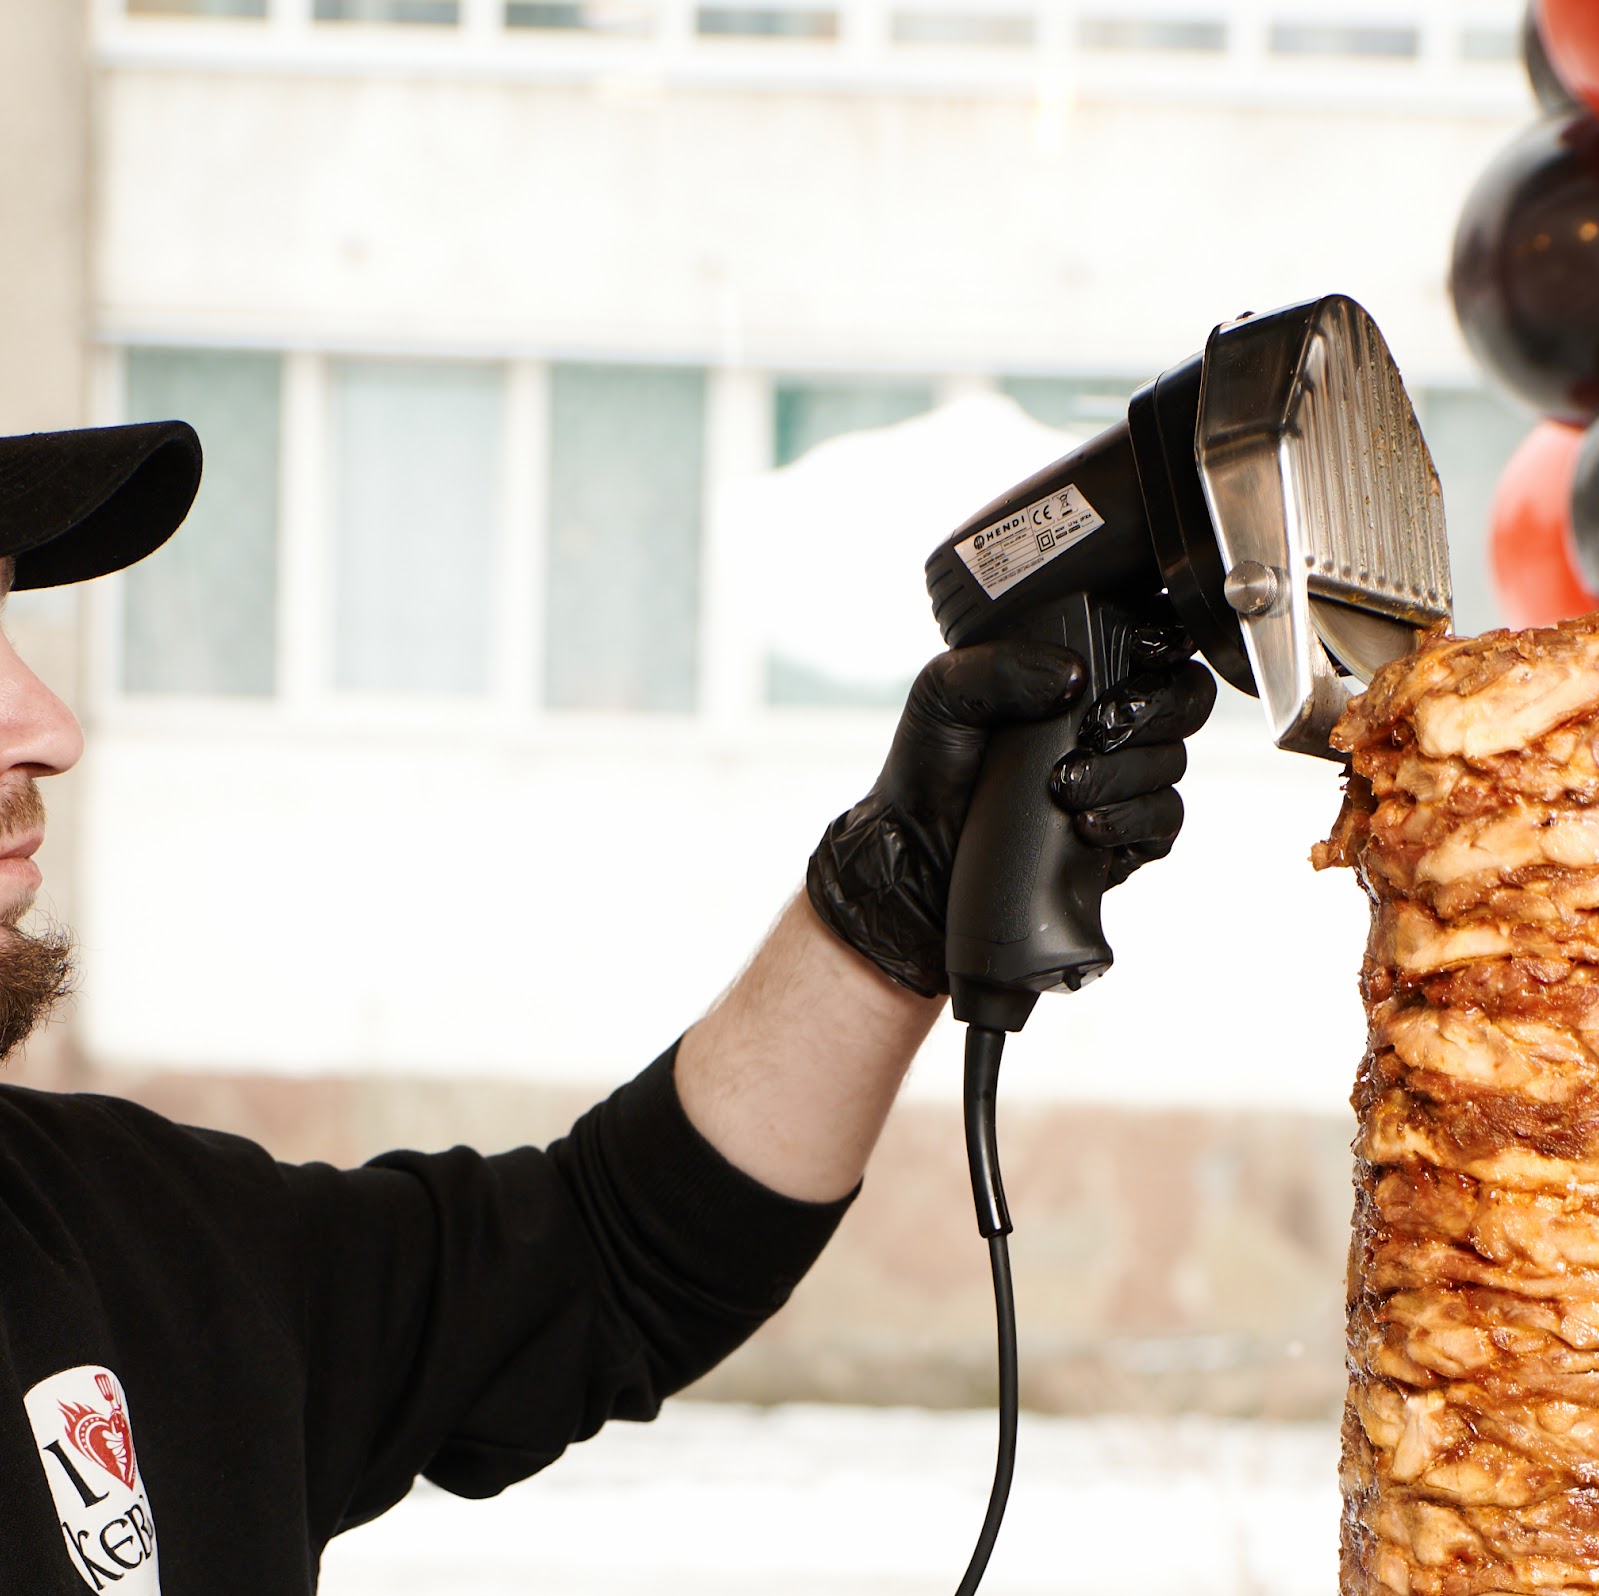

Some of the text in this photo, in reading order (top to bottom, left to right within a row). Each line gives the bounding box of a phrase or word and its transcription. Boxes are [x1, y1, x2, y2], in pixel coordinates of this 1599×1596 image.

[986, 515, 1026, 542] HENDI
[43, 1439, 109, 1508] I
[60, 1494, 154, 1591] KEB
